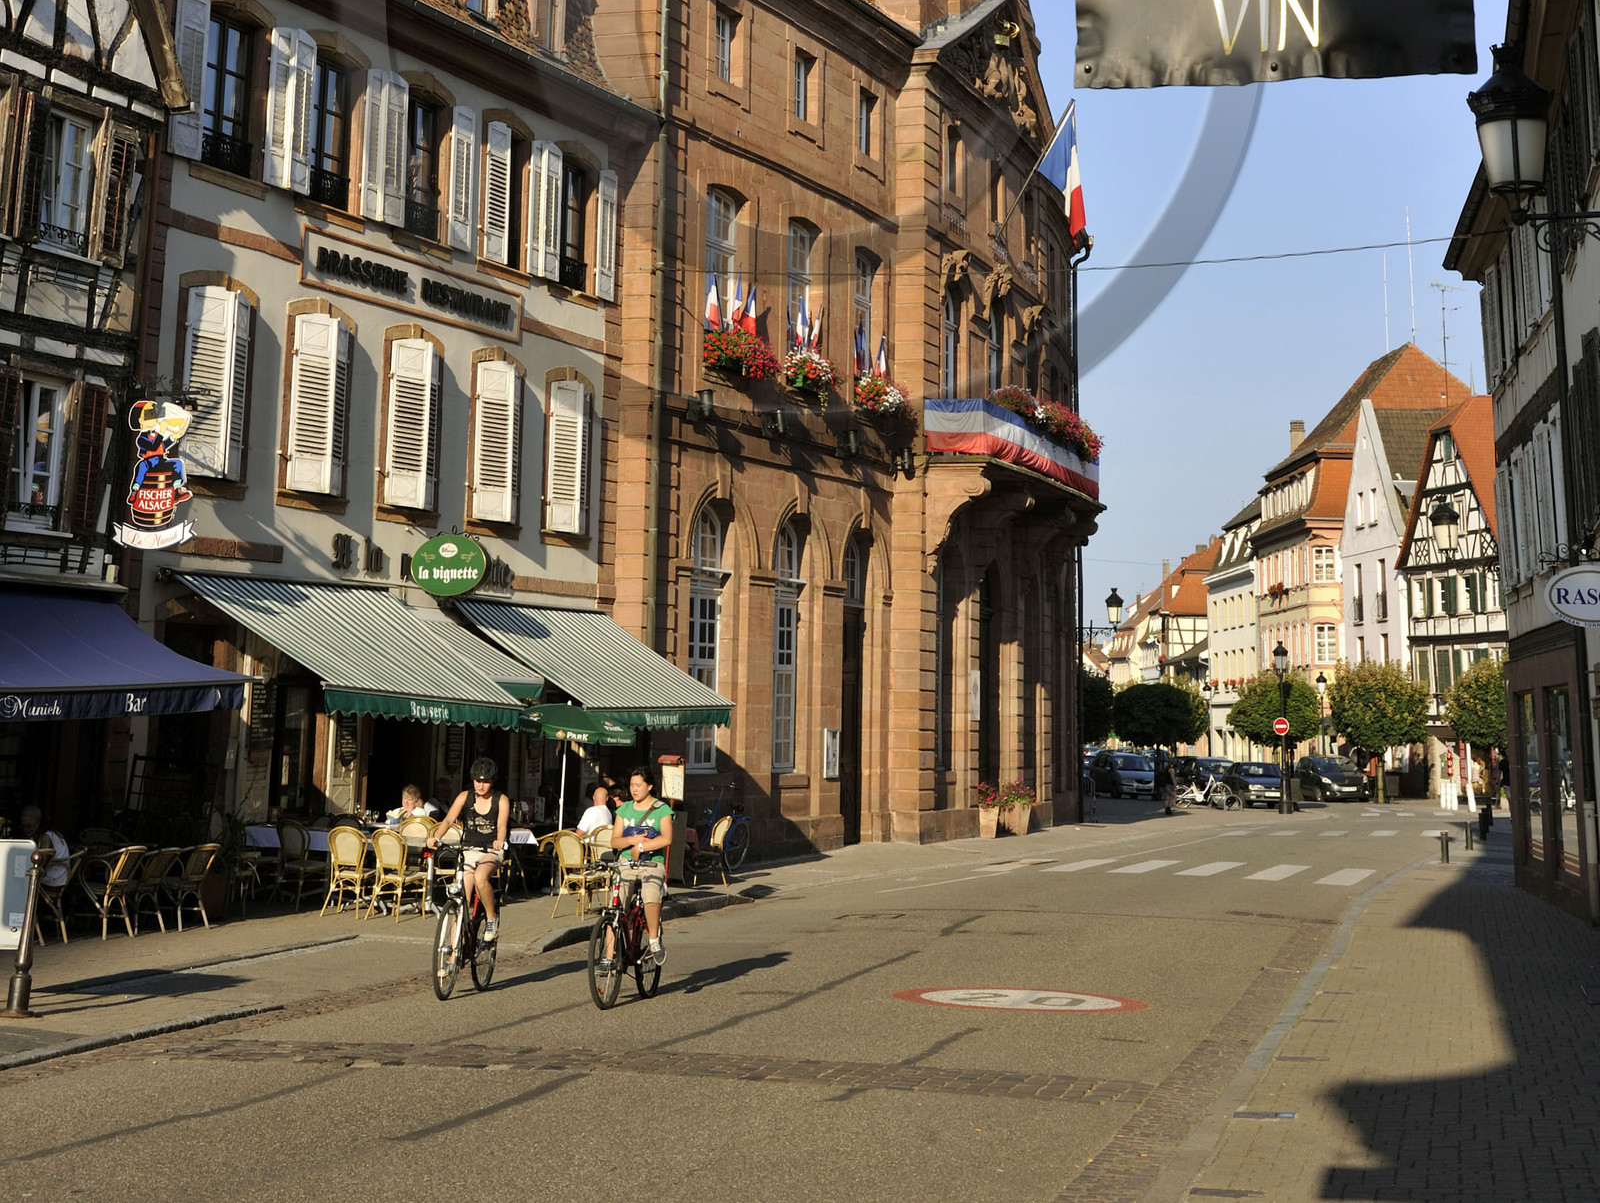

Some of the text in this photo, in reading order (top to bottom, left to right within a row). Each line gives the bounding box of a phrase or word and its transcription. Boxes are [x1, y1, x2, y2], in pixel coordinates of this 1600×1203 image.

[316, 246, 511, 325] BRASSERIE RESTAURANT
[139, 489, 172, 500] FISCHER
[138, 499, 172, 510] ALSACE
[418, 565, 430, 580] la
[433, 565, 478, 583] vignette
[1555, 587, 1600, 605] RAS
[2, 693, 147, 718] Munich Bar
[410, 701, 449, 718] Brasserie
